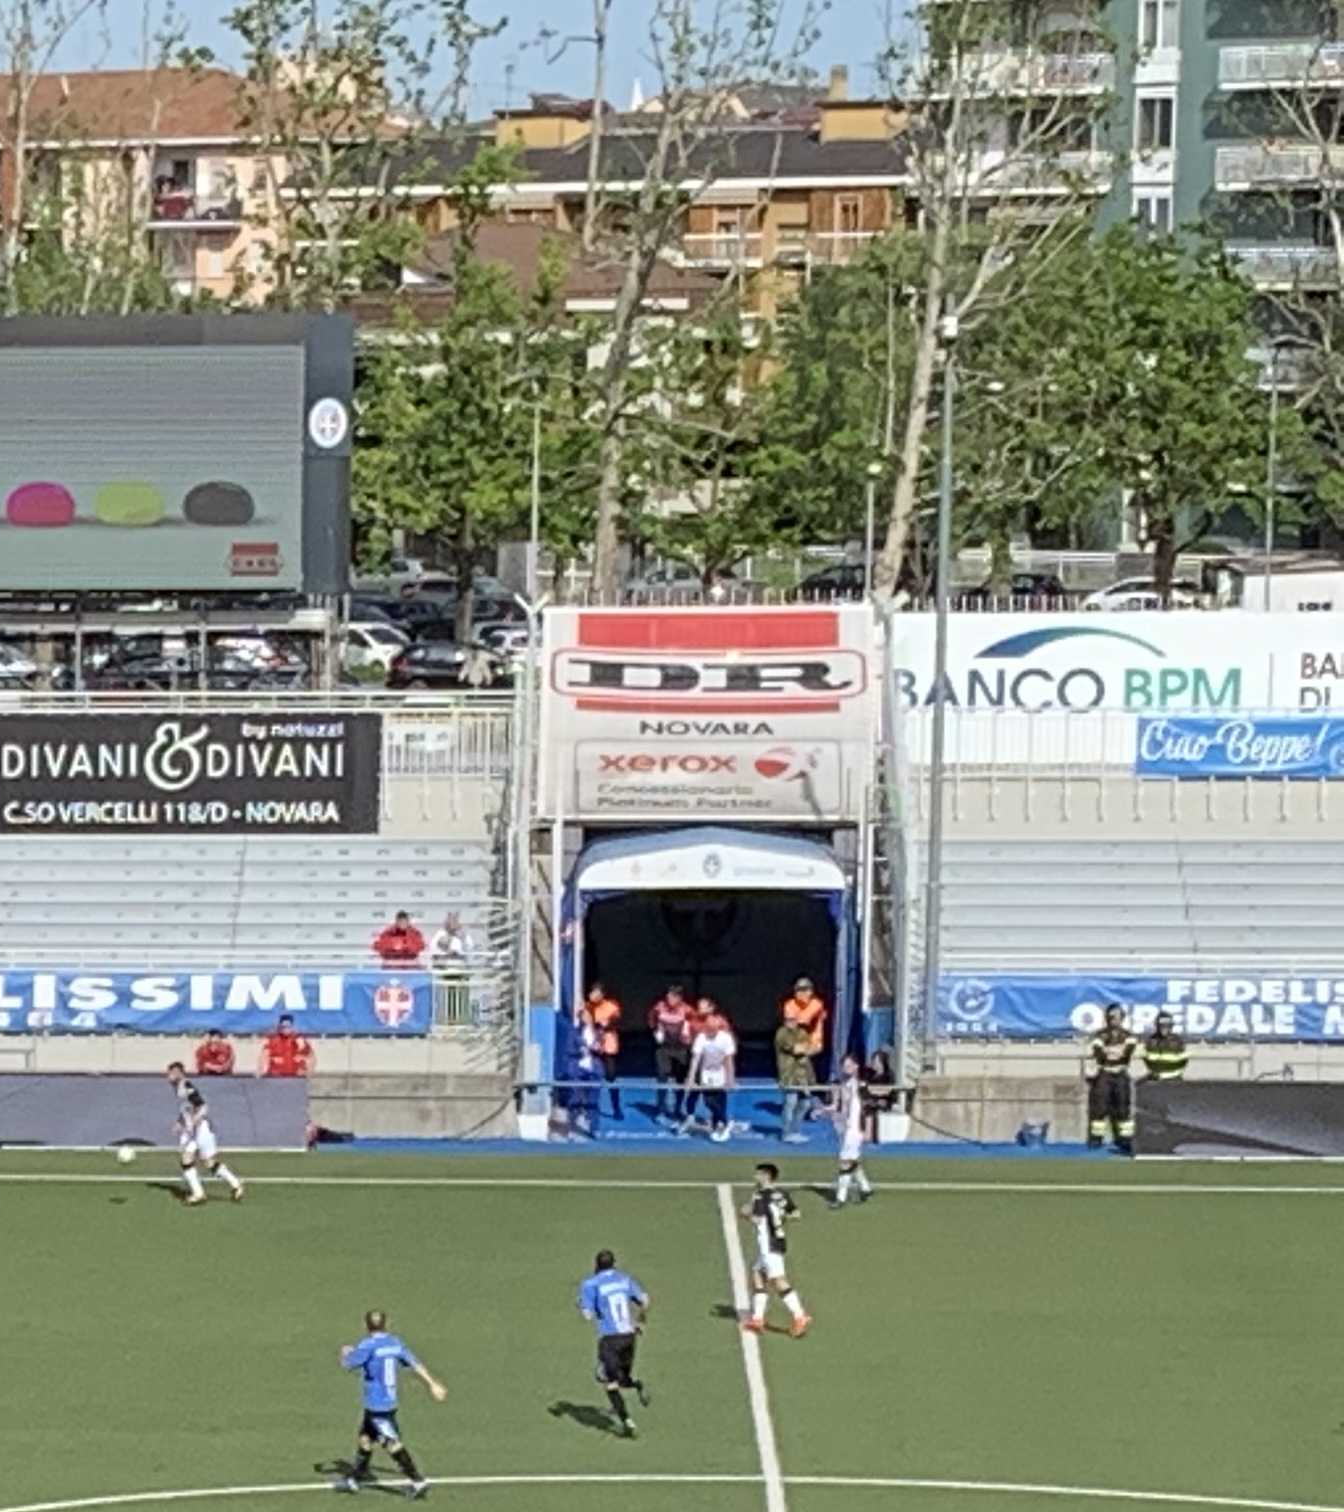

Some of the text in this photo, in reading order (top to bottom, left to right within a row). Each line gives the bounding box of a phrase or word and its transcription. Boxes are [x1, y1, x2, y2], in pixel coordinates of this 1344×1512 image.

[568, 658, 853, 693] DR
[1301, 652, 1344, 680] BA
[892, 667, 1242, 713] BANCO BPM
[1298, 686, 1331, 714] DI
[242, 721, 267, 740] by
[639, 720, 775, 736] NOVARA
[598, 754, 738, 774] xerox
[60, 800, 158, 823] VERCELLI
[164, 801, 227, 823] 118/D
[246, 800, 340, 823] NOVARA
[1166, 980, 1344, 1003] FEDELI
[1070, 1005, 1296, 1034] OPEDALE
